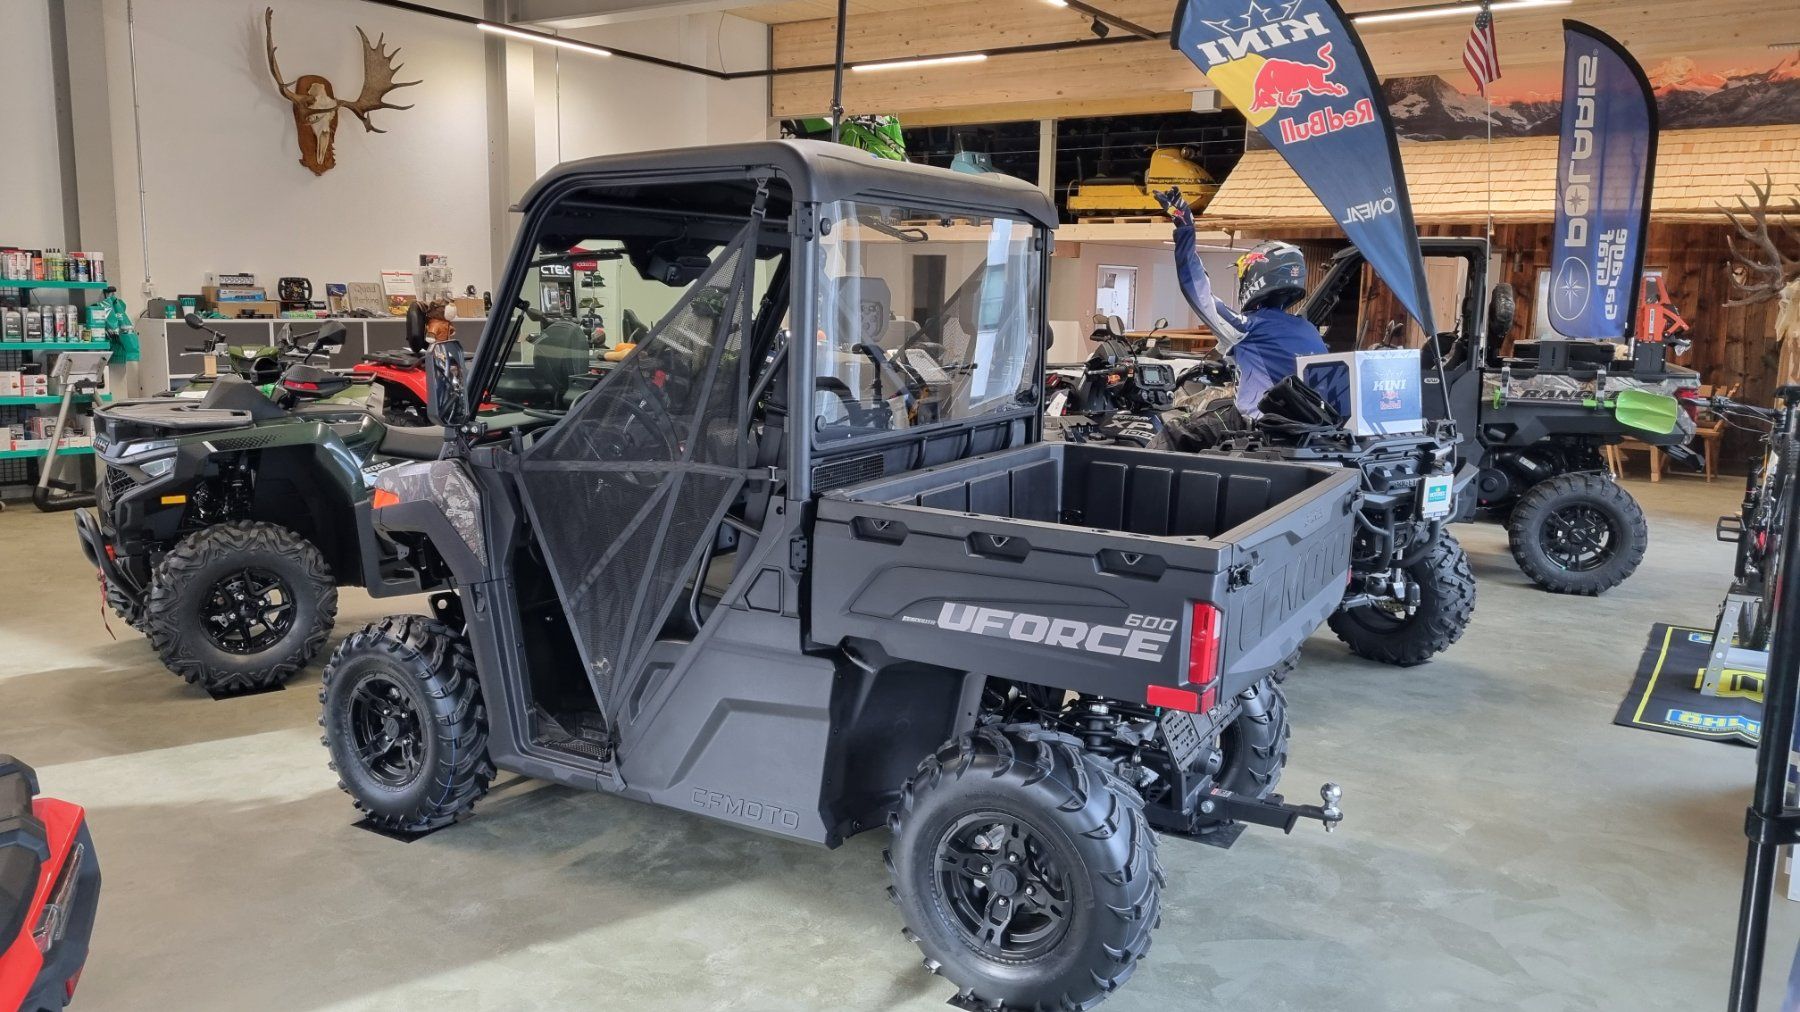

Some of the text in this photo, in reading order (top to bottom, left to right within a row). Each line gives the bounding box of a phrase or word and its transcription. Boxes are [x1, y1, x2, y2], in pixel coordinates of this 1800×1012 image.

[541, 264, 571, 275] CTEK
[1373, 379, 1407, 391] KINI
[1521, 389, 1622, 400] RANG
[1104, 420, 1154, 430] XP
[361, 462, 391, 473] ROSS
[1124, 613, 1178, 632] 600
[937, 601, 1172, 663] UFORCE
[692, 787, 800, 830] CFMOTO
